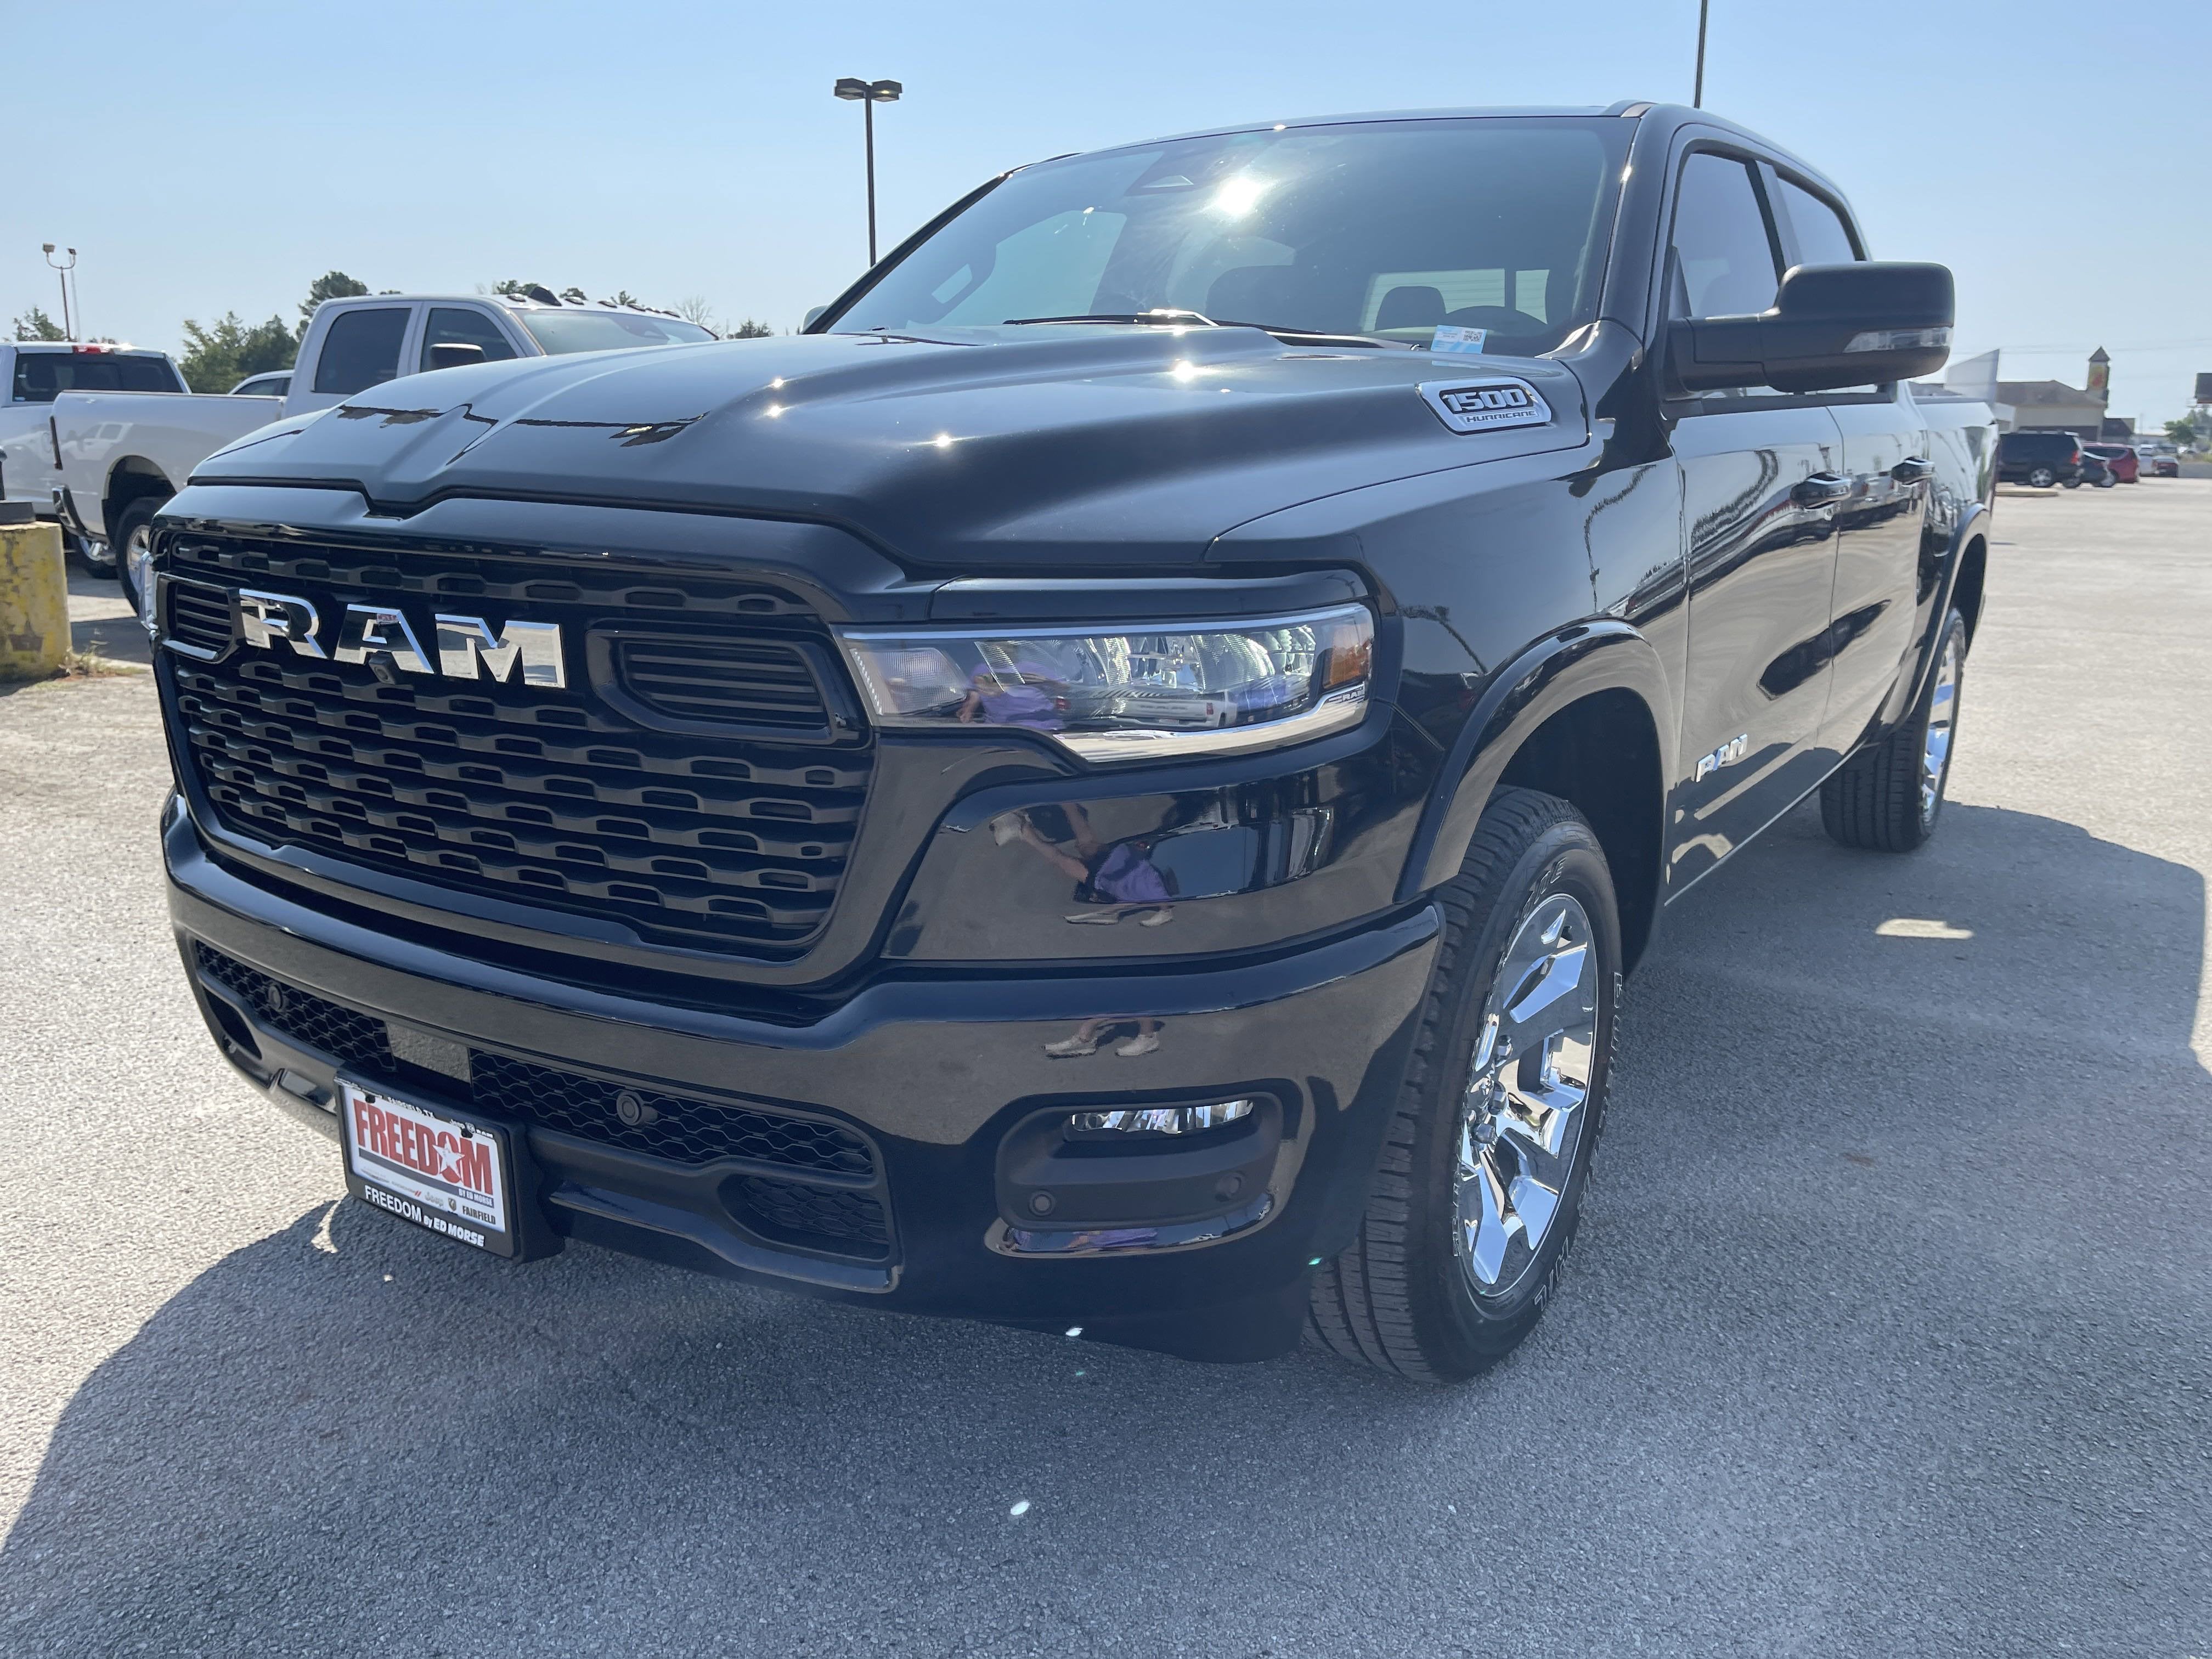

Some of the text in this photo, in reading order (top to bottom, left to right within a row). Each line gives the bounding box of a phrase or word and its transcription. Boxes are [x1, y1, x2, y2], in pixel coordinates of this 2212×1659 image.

[1442, 388, 1527, 412] 1500
[1466, 410, 1536, 422] HURRICANE
[239, 588, 566, 689] RAM
[1695, 733, 1748, 783] RAM
[353, 1098, 494, 1195] FREEDOM
[365, 1185, 422, 1222] FREEDOM
[433, 1217, 447, 1232] ED
[448, 1223, 484, 1247] MORSE
[458, 1188, 493, 1207] BY ED MORSE
[462, 1205, 496, 1225] FAIRFIELD
